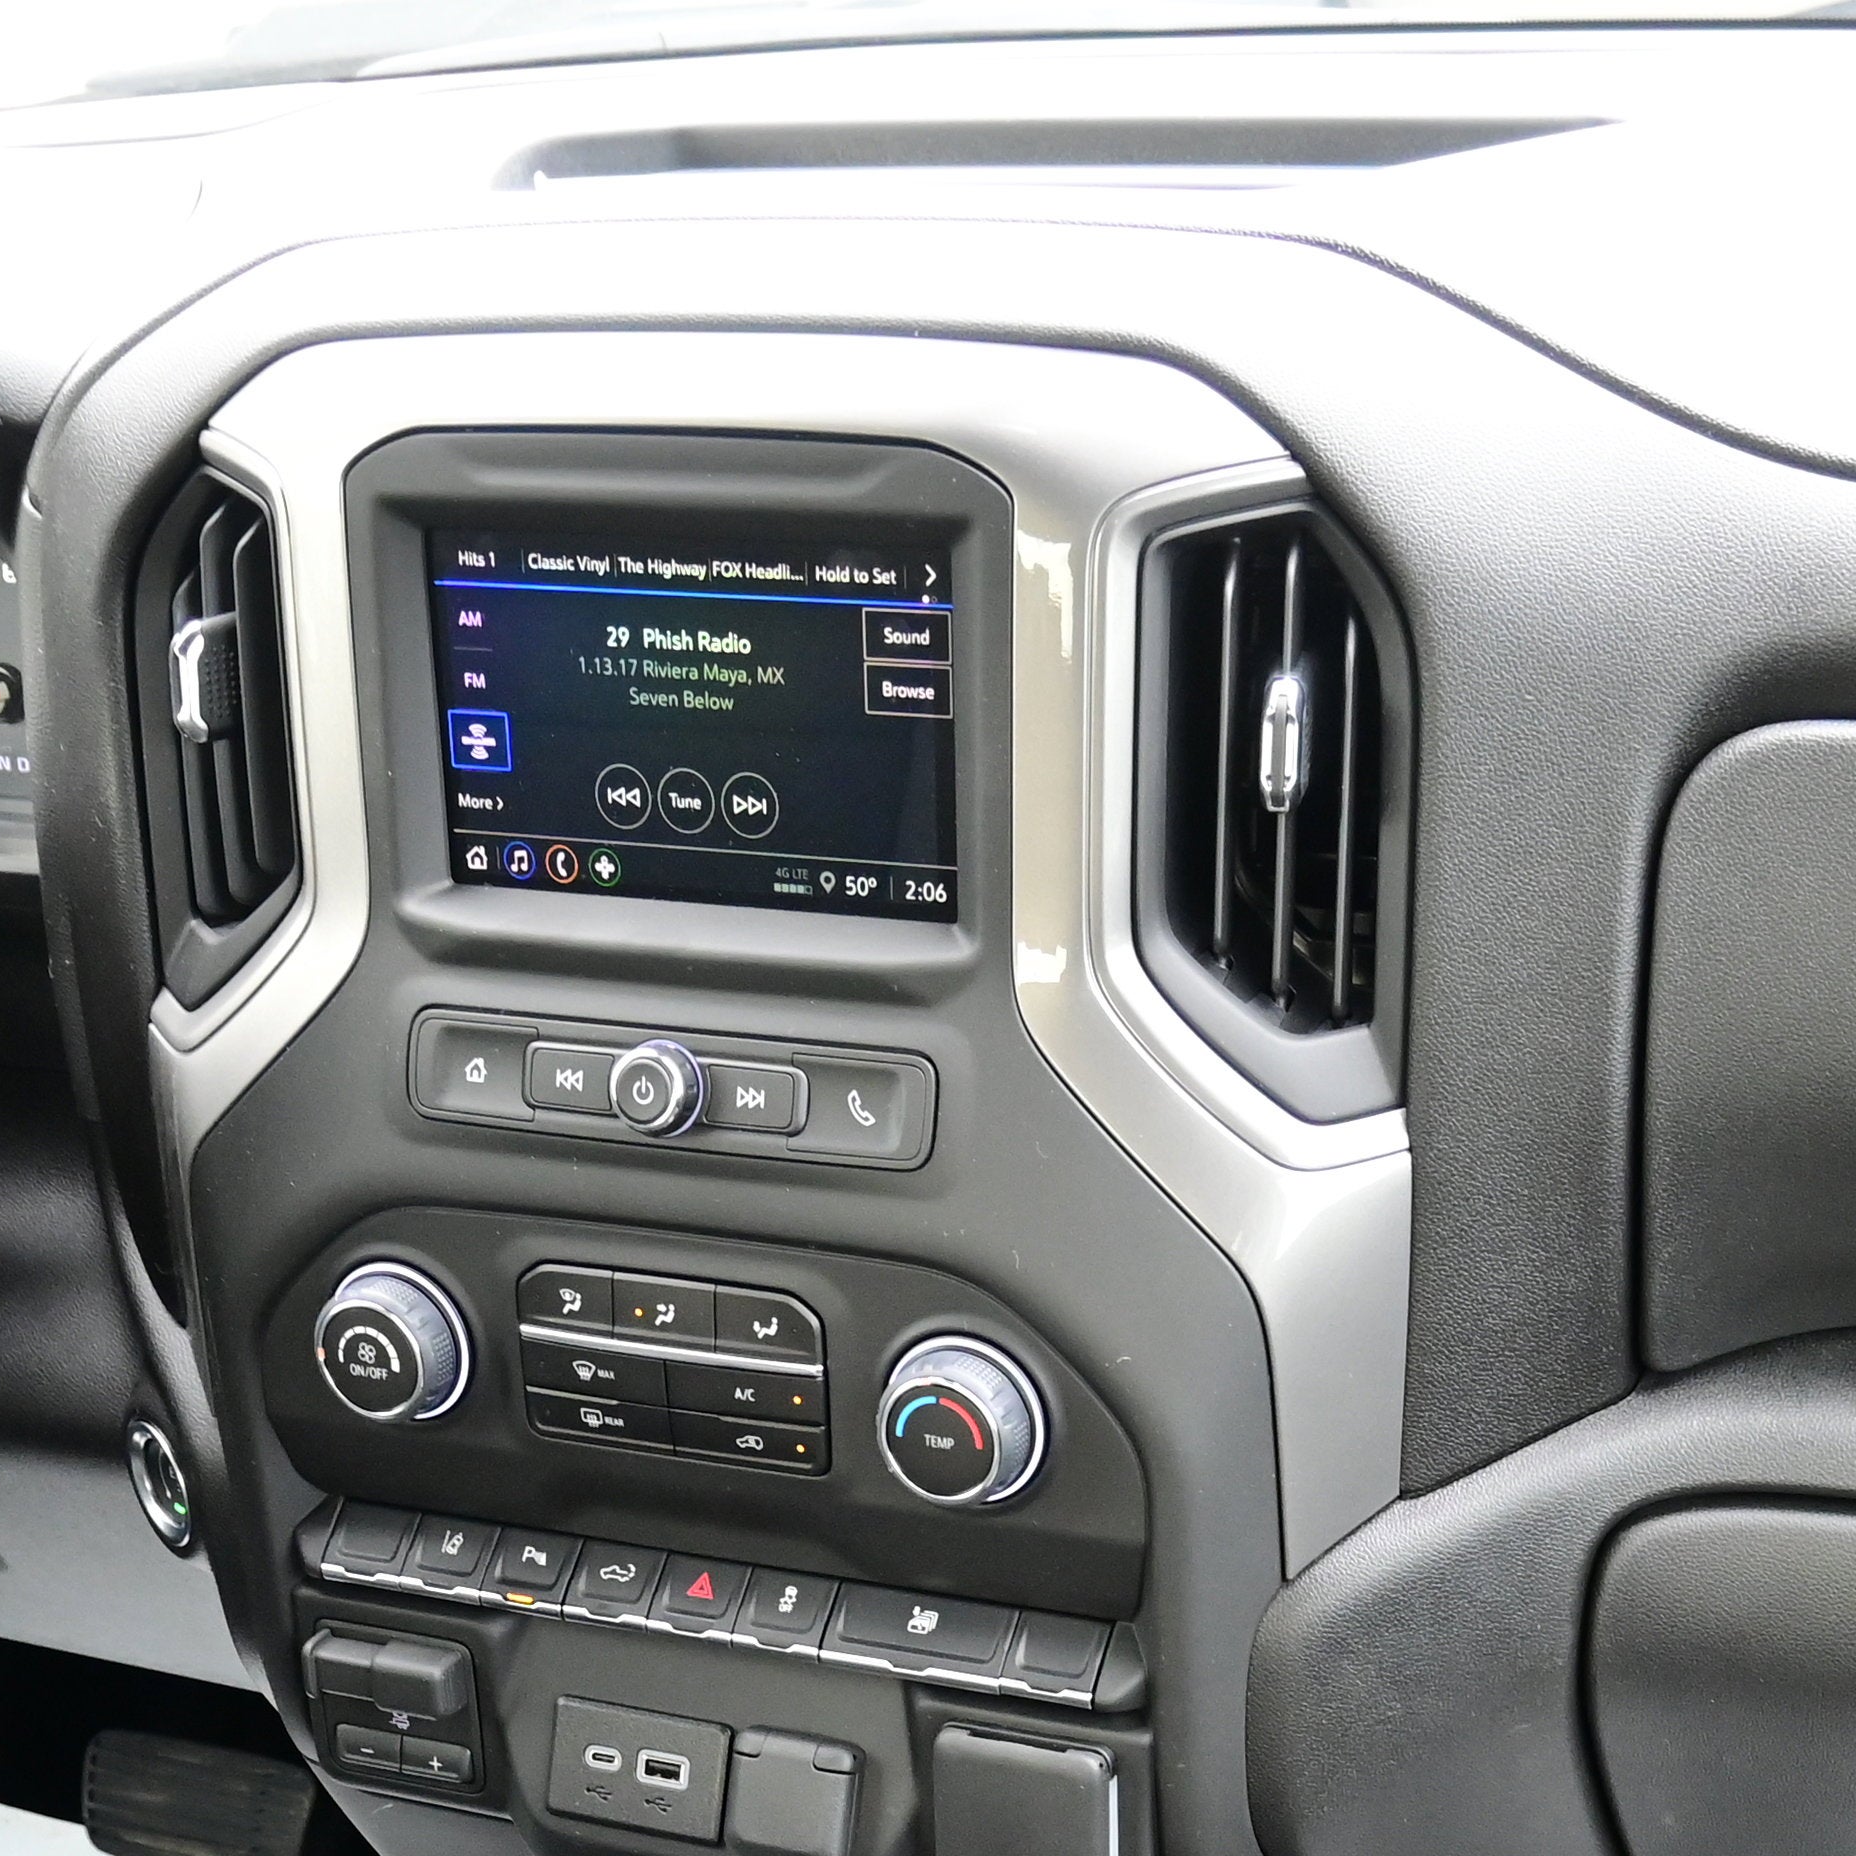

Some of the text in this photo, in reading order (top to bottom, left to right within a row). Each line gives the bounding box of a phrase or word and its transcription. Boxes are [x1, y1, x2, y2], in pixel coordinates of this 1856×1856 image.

[458, 550, 496, 567] Hits 1
[527, 553, 611, 576] Classic Vinyl
[617, 557, 707, 580] The Highway
[712, 561, 804, 581] FOX Headli...
[815, 565, 897, 586] Hold to Set
[459, 611, 483, 627] AM
[606, 626, 751, 655] 29 Phish Radio
[883, 627, 930, 646] Sound
[464, 672, 486, 689] FM
[579, 656, 785, 687] 1.13.17 Riviera Maya, MX
[629, 687, 734, 711] Seven Below
[882, 681, 935, 700] Browse
[17, 757, 31, 773] D
[458, 793, 493, 811] More
[669, 792, 702, 810] Tune
[775, 867, 809, 880] 4G LTE
[905, 880, 947, 903] 2:06
[349, 1362, 389, 1381] ON/OFF
[597, 1368, 616, 1380] MAX
[734, 1387, 755, 1402] A/C
[604, 1416, 624, 1428] REAR
[923, 1433, 955, 1450] TEMP
